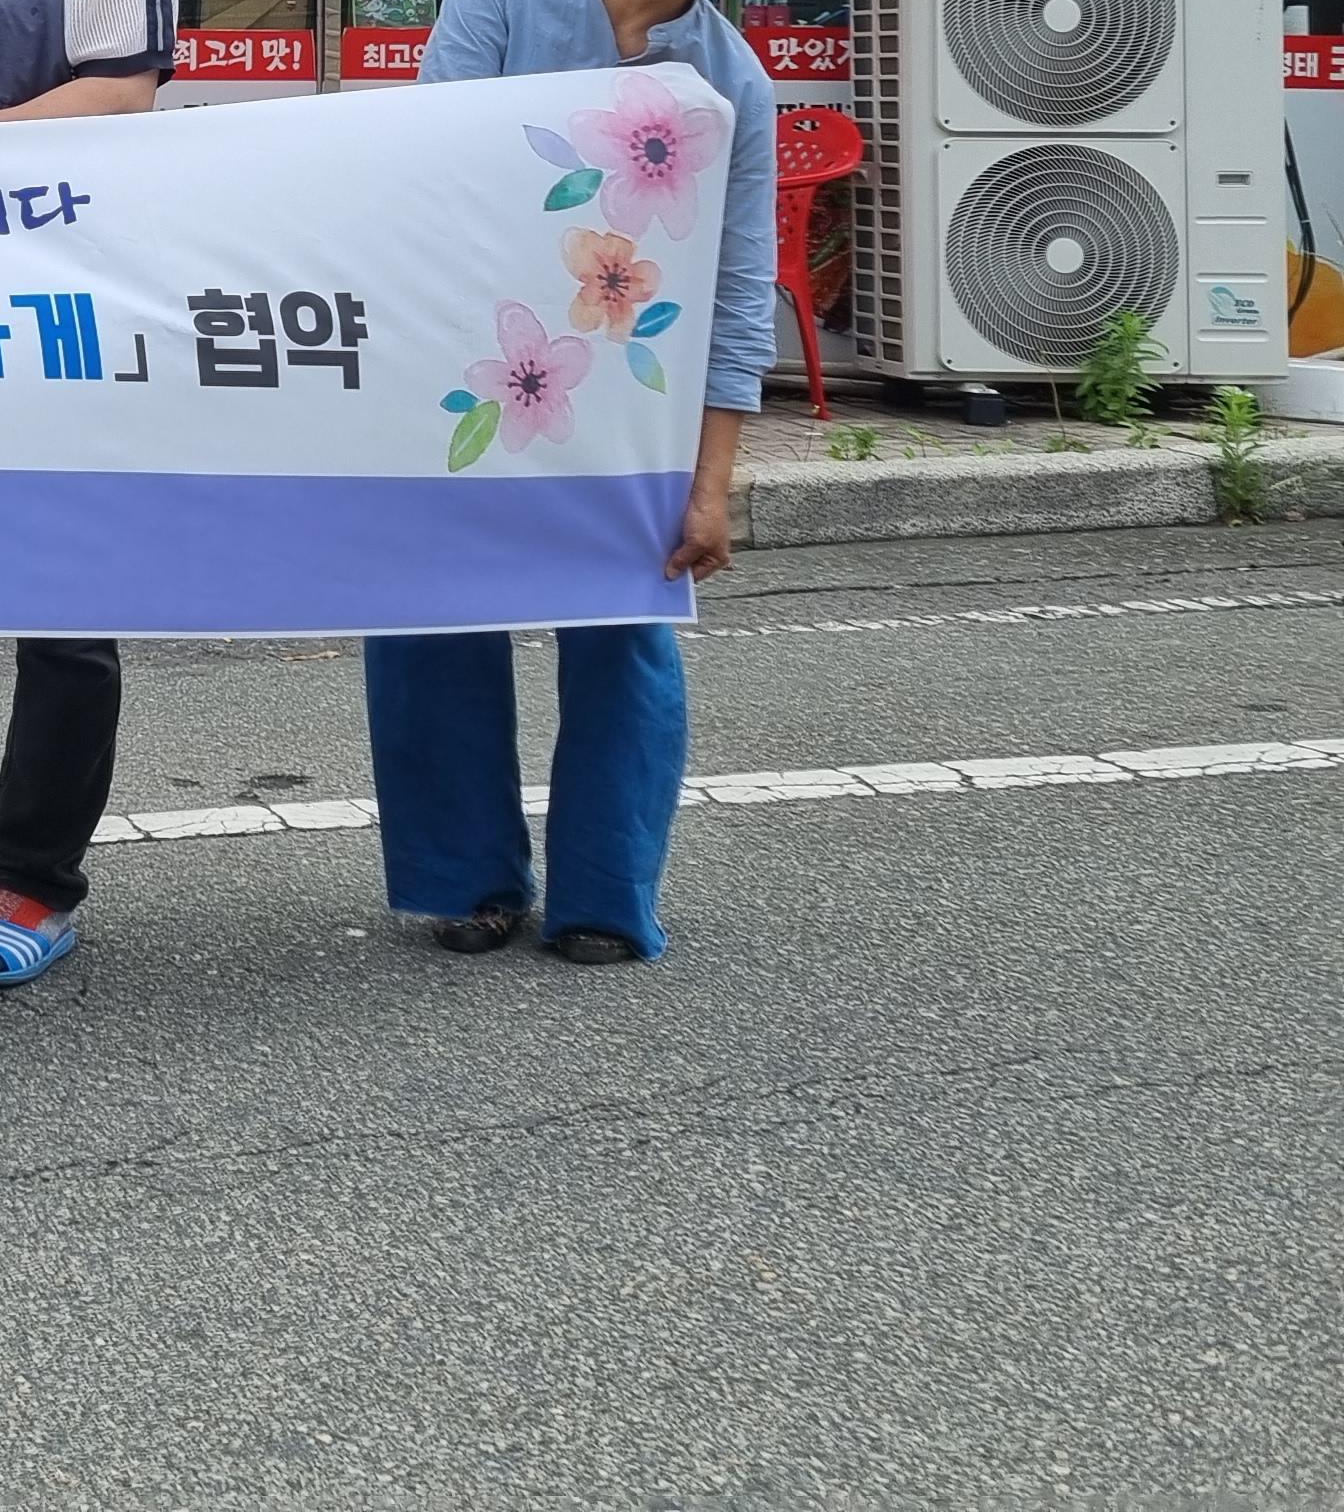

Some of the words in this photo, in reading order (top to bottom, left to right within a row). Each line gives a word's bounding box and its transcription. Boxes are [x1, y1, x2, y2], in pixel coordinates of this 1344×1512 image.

[173, 37, 253, 72] 최고의
[261, 37, 303, 72] 맛!
[186, 287, 369, 390] 협약
